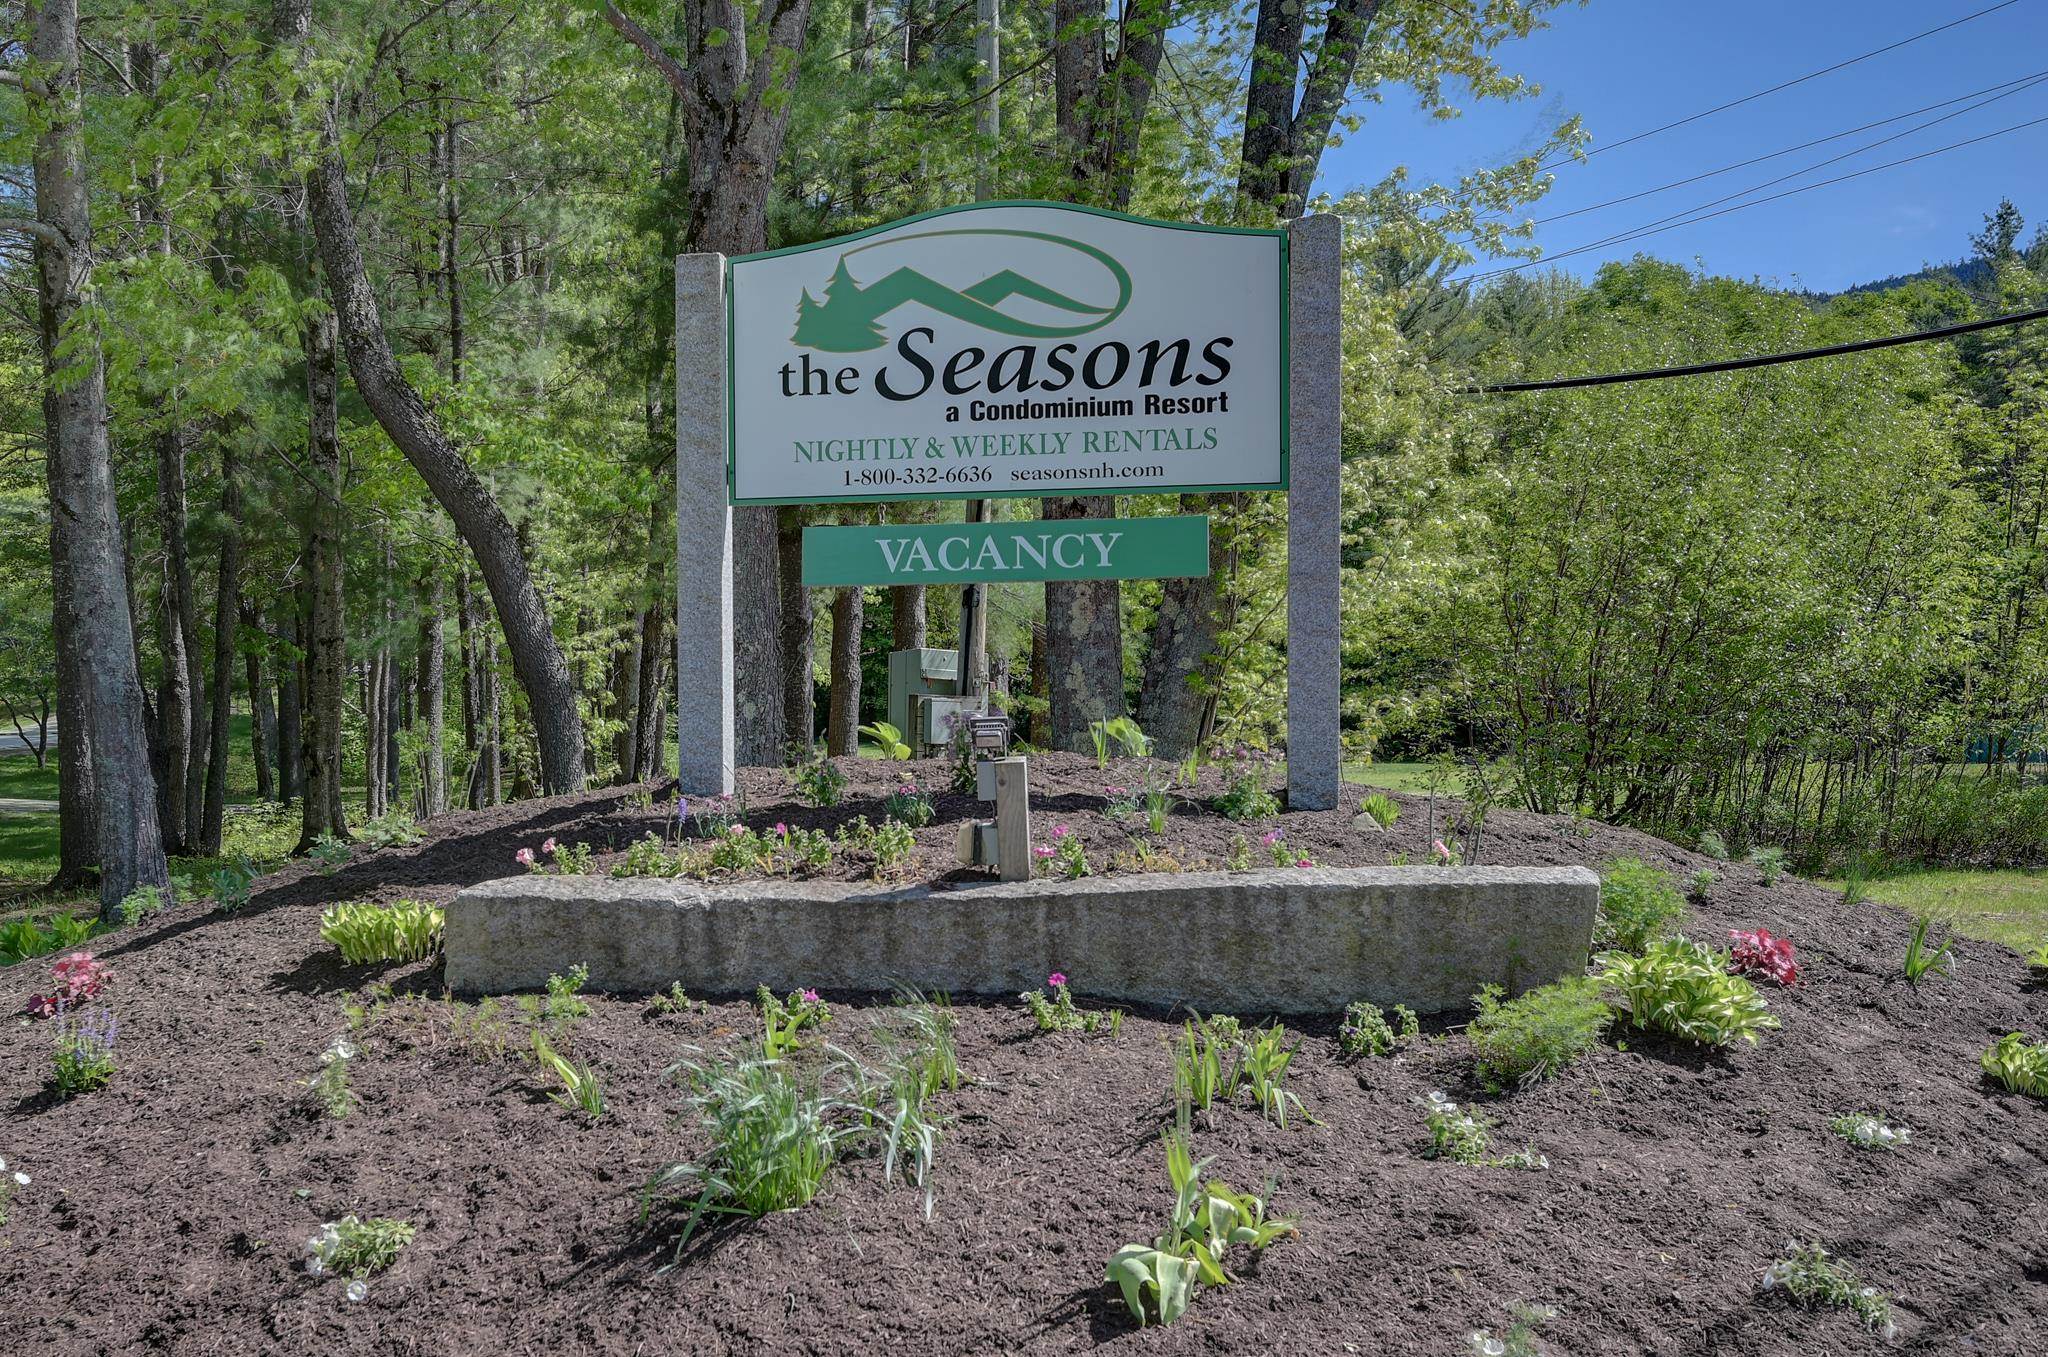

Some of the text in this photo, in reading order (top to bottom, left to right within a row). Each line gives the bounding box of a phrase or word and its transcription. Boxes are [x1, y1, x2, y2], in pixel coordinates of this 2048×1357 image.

[778, 327, 1234, 402] the Seasons
[945, 391, 1229, 423] a Condominium Resort
[793, 427, 1219, 464] NIGHTLY & WEEKLY RENTALS
[843, 462, 1164, 487] 1-800-332-6636 seasonsnh.com
[875, 532, 1123, 574] VACANCY
